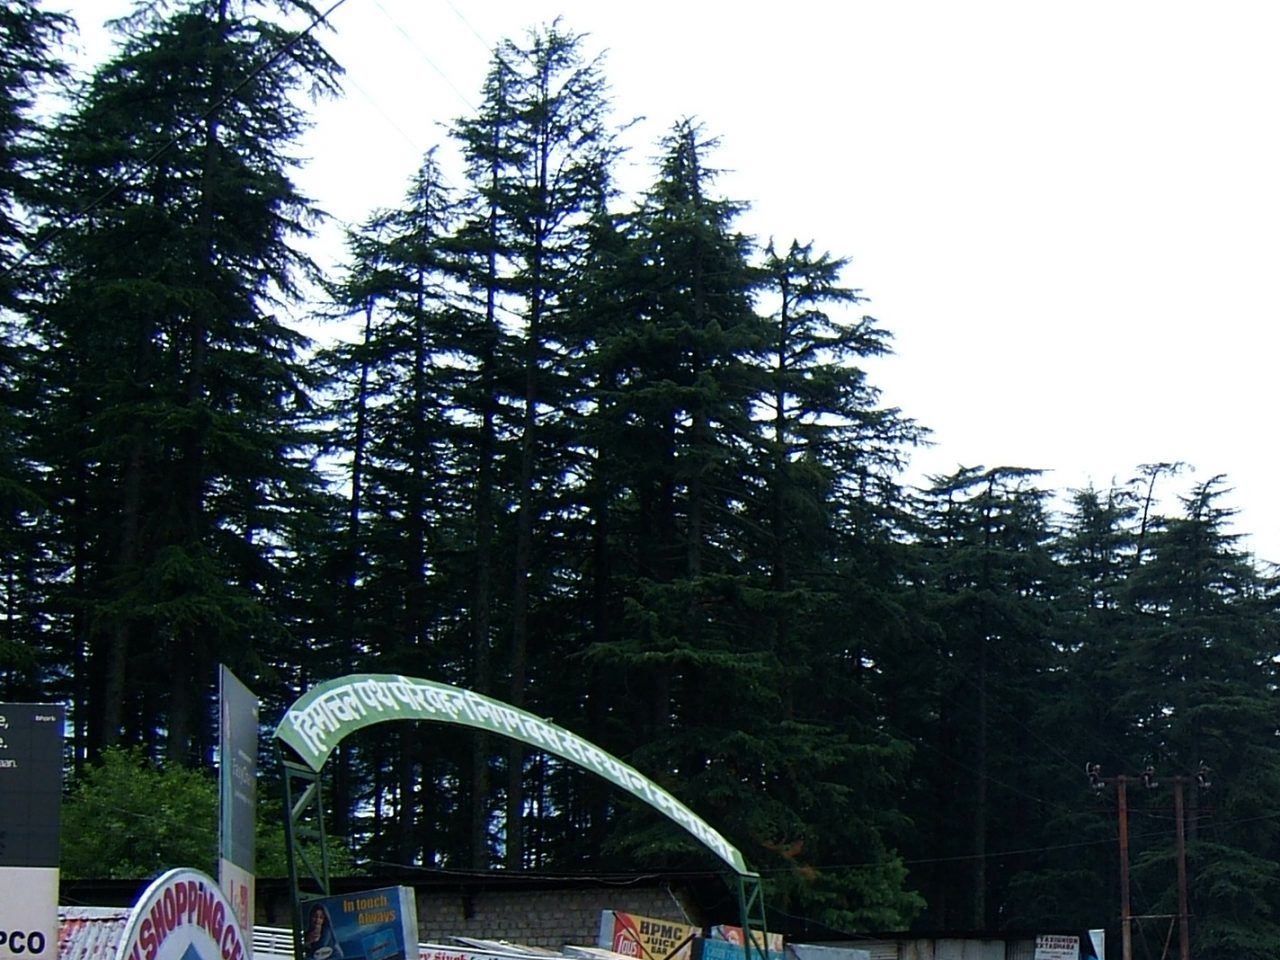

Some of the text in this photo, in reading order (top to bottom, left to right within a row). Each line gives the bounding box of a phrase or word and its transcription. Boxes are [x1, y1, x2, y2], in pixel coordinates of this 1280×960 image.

[343, 895, 388, 913] In touch
[358, 910, 396, 925] Always
[640, 921, 683, 940] HPMC
[644, 937, 676, 948] JUICE
[651, 946, 668, 955] BAR
